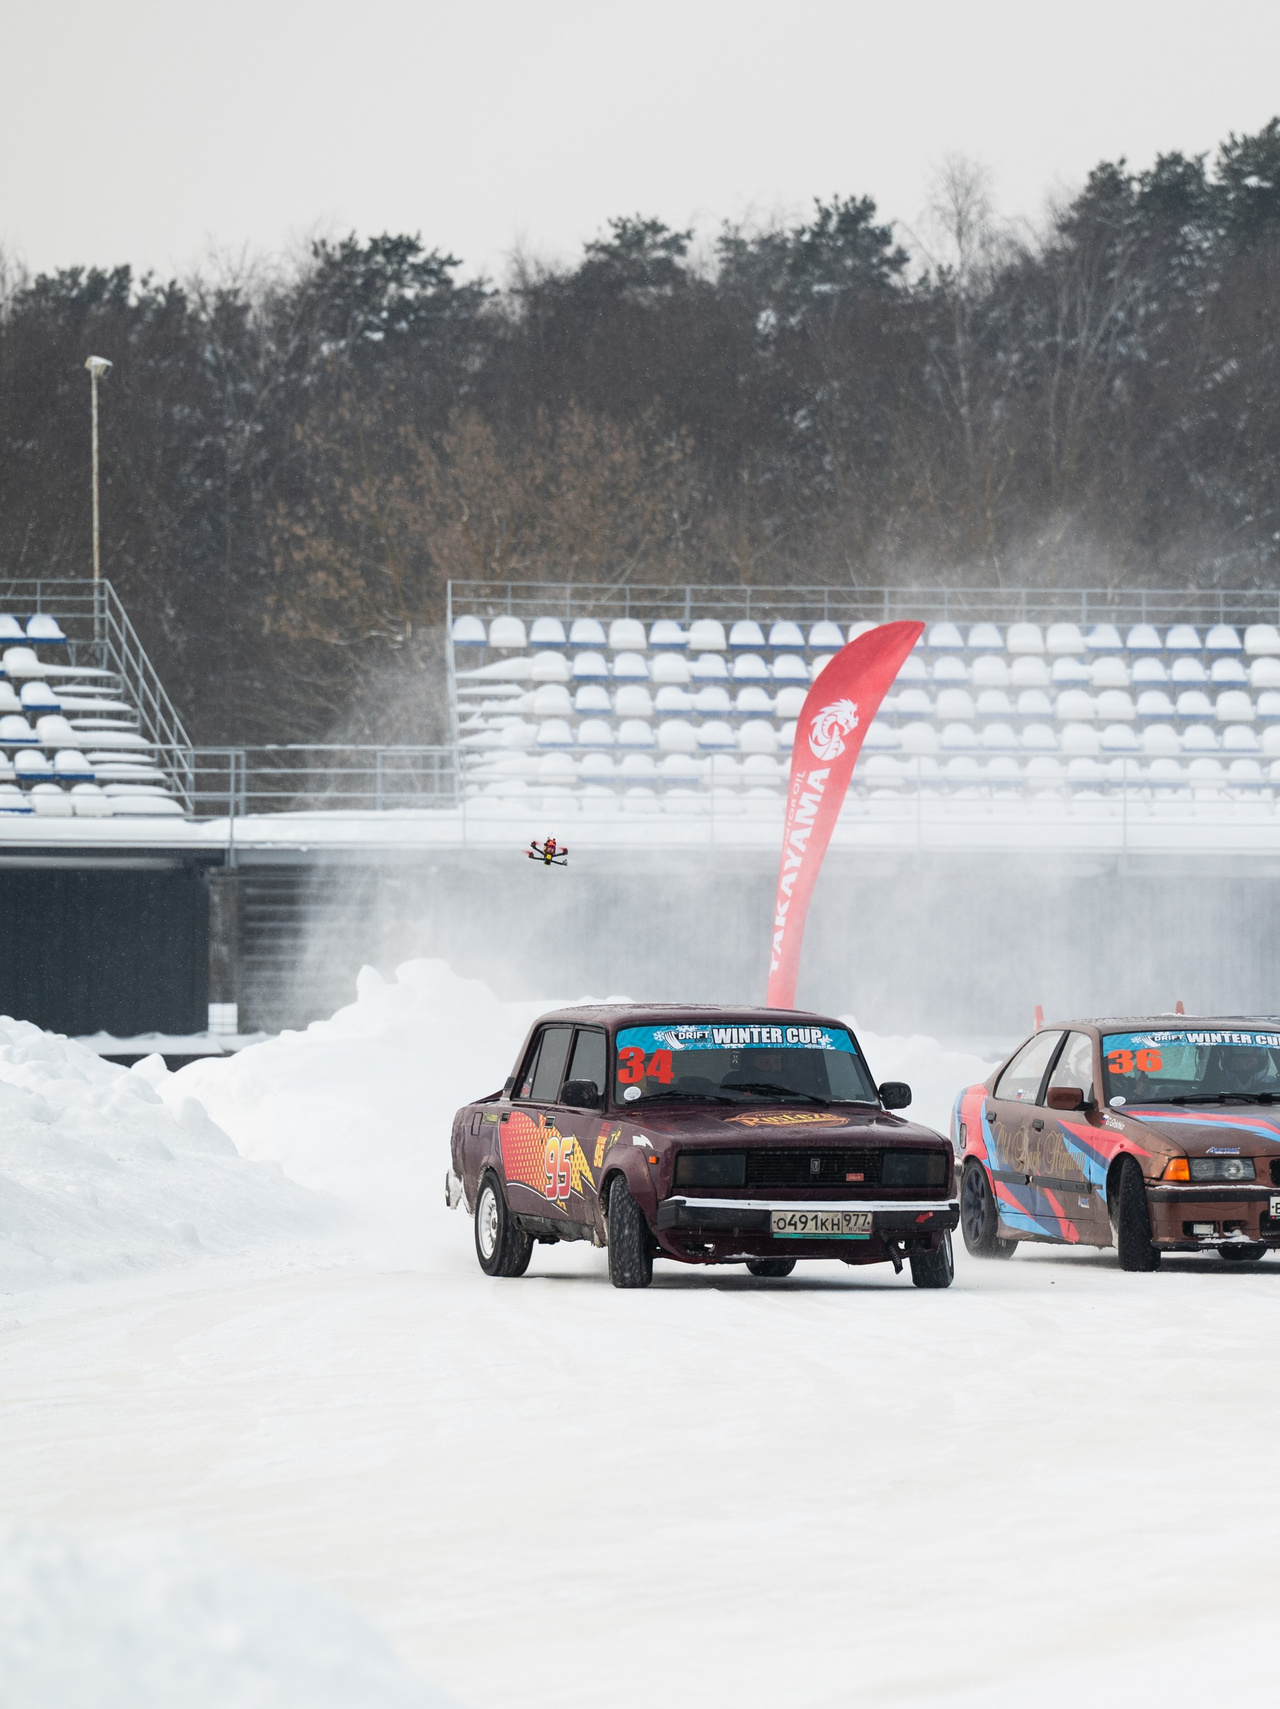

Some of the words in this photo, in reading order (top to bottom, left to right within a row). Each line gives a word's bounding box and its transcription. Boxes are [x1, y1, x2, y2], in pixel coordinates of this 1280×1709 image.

[792, 770, 806, 795] OIL
[769, 767, 831, 978] TAKAYAMA
[678, 1030, 710, 1040] DRIFT
[712, 1027, 783, 1045] WINTER
[785, 1027, 823, 1044] CUP
[1153, 1034, 1184, 1042] DRIFT
[1186, 1033, 1255, 1045] WINTER
[617, 1046, 675, 1085] 34
[1107, 1048, 1163, 1074] 36
[593, 1143, 606, 1168] 95
[545, 1136, 574, 1201] 95
[843, 1213, 868, 1227] 977
